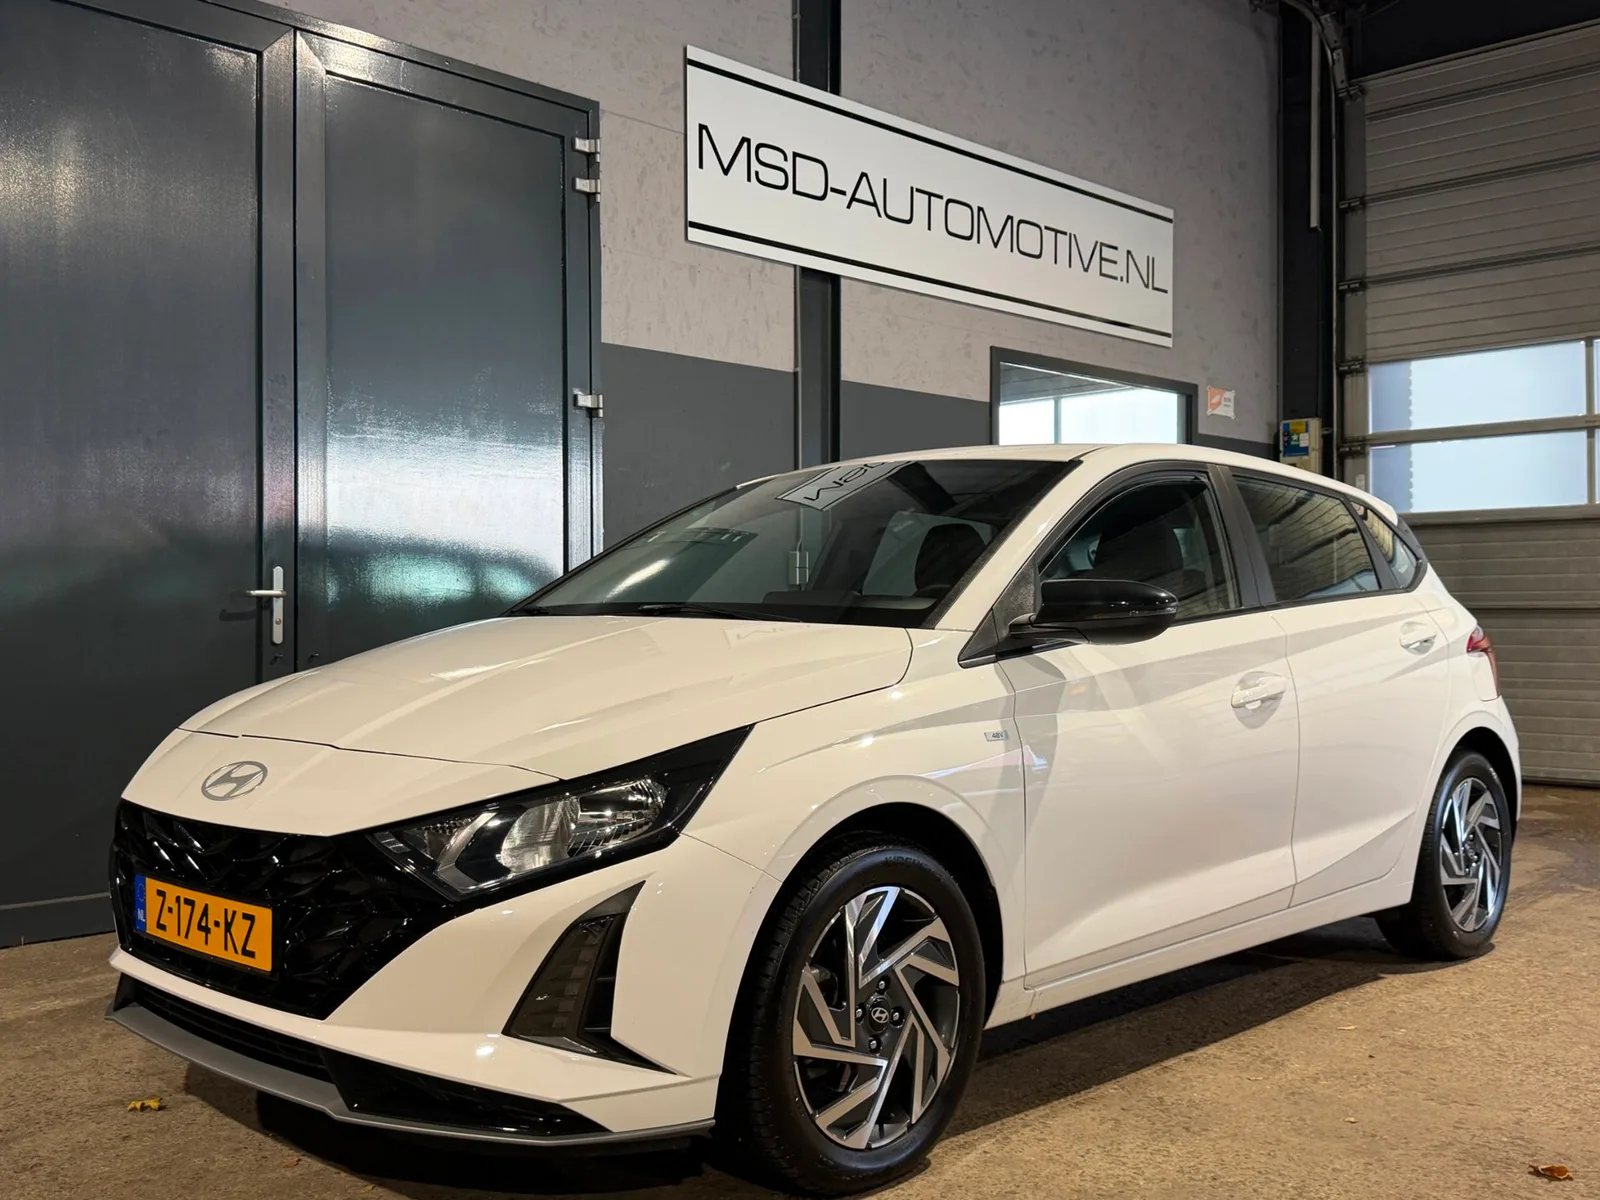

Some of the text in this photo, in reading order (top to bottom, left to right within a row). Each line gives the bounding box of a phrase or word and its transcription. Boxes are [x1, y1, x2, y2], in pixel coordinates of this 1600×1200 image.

[698, 123, 1168, 293] MSD-AUTOMOTIVE.NL
[137, 908, 146, 922] NL
[156, 889, 256, 959] Z-174-KZ
